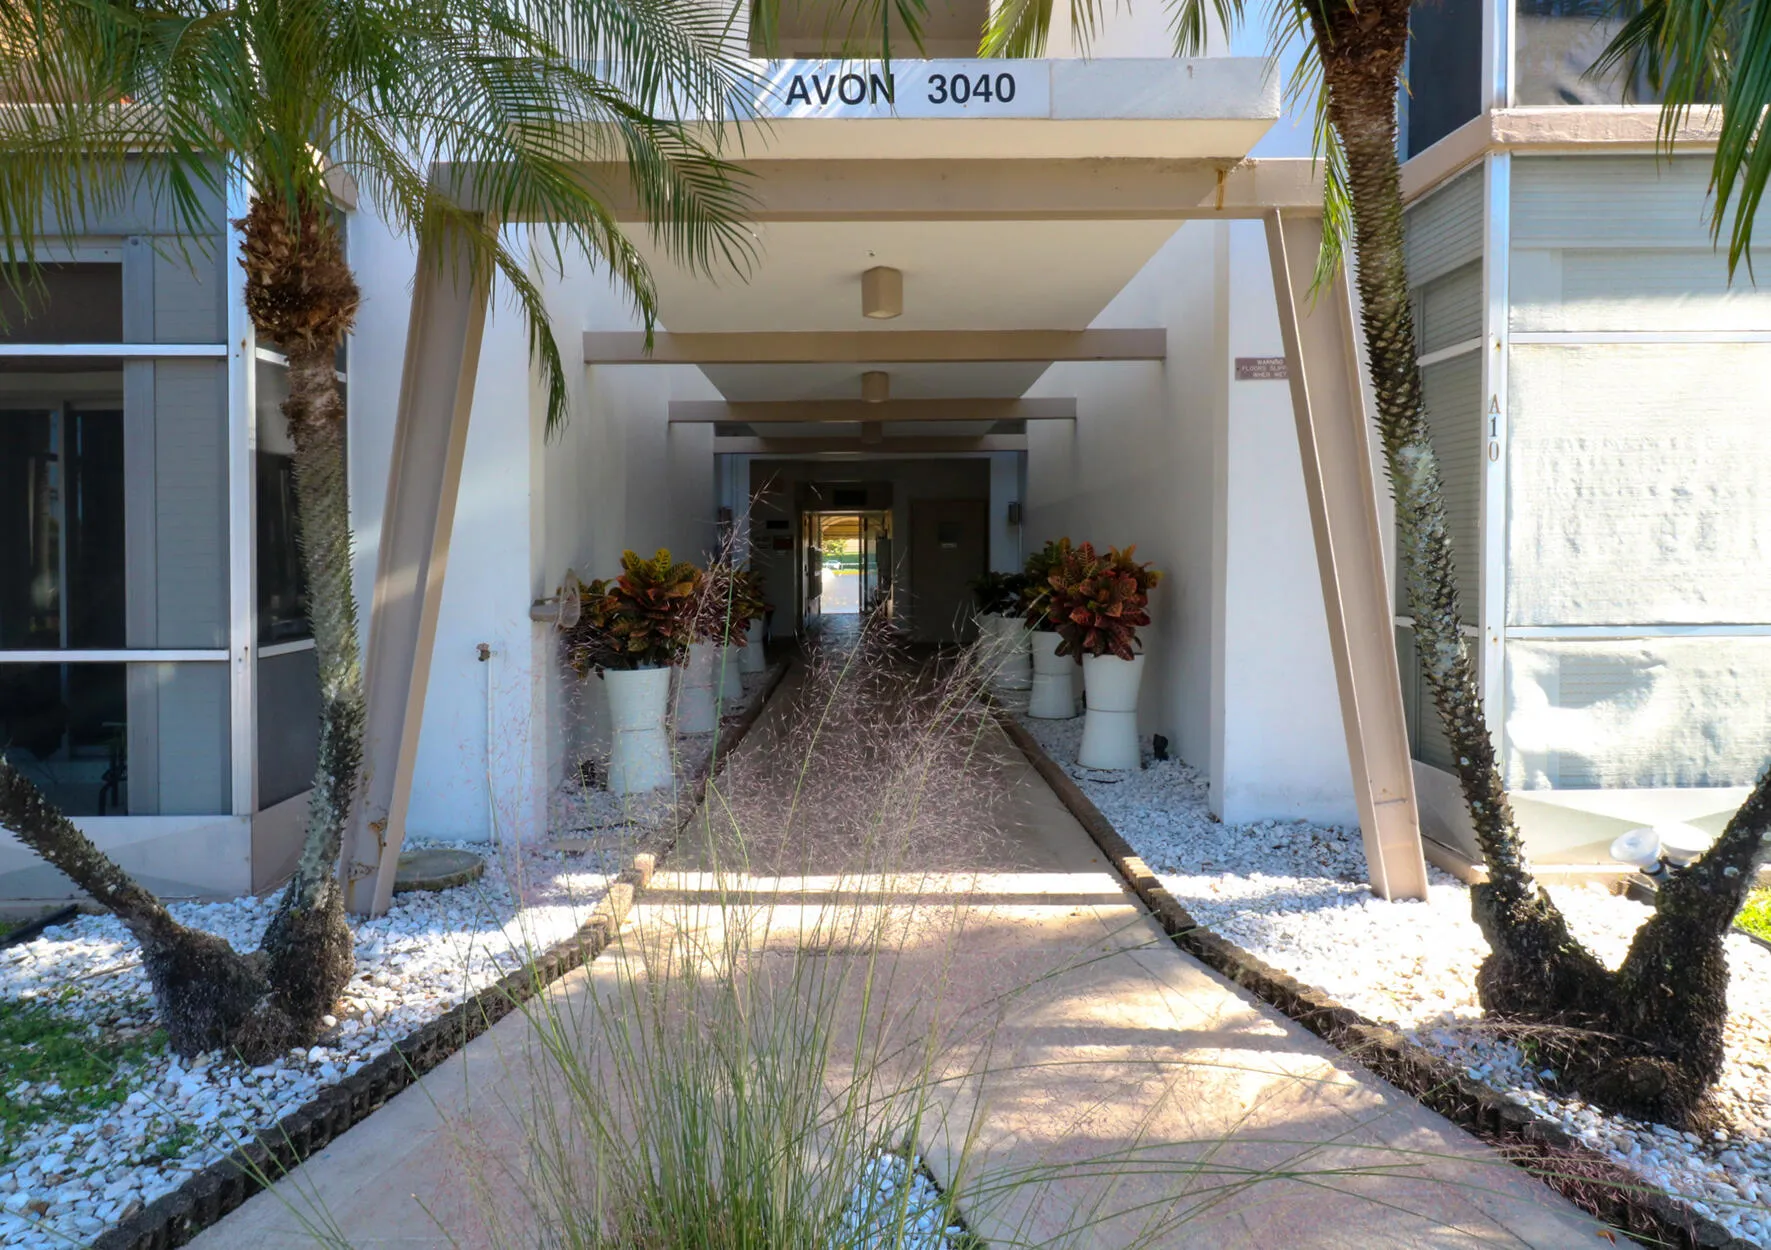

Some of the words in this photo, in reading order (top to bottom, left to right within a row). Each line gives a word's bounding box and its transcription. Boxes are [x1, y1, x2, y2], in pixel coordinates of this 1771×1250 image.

[785, 74, 895, 105] AVON
[927, 72, 1016, 104] 3040
[1488, 393, 1501, 463] A10
